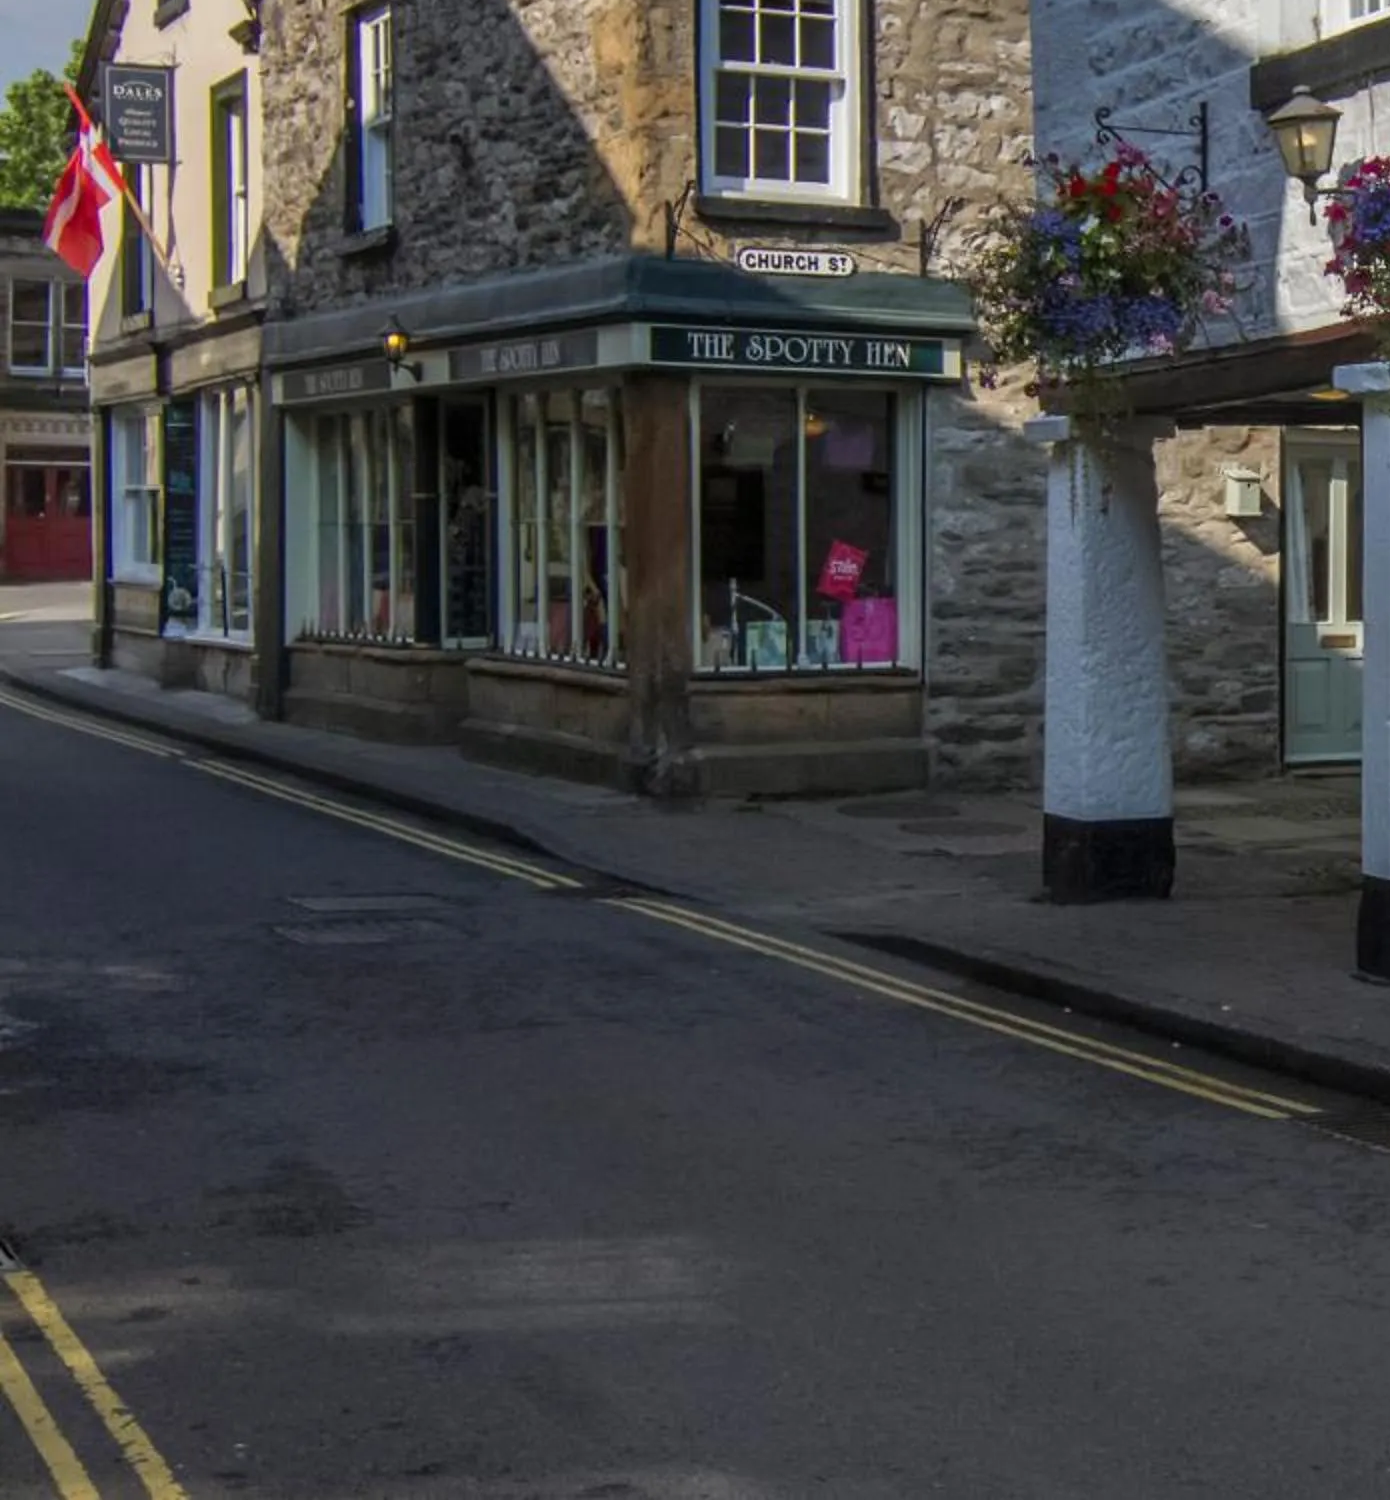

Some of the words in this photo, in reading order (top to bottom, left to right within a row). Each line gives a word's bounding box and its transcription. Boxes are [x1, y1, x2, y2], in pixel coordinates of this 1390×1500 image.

[745, 253, 819, 271] CHURCH
[687, 331, 735, 360] THE
[746, 334, 855, 364] SPOTTY
[866, 340, 912, 369] HEN
